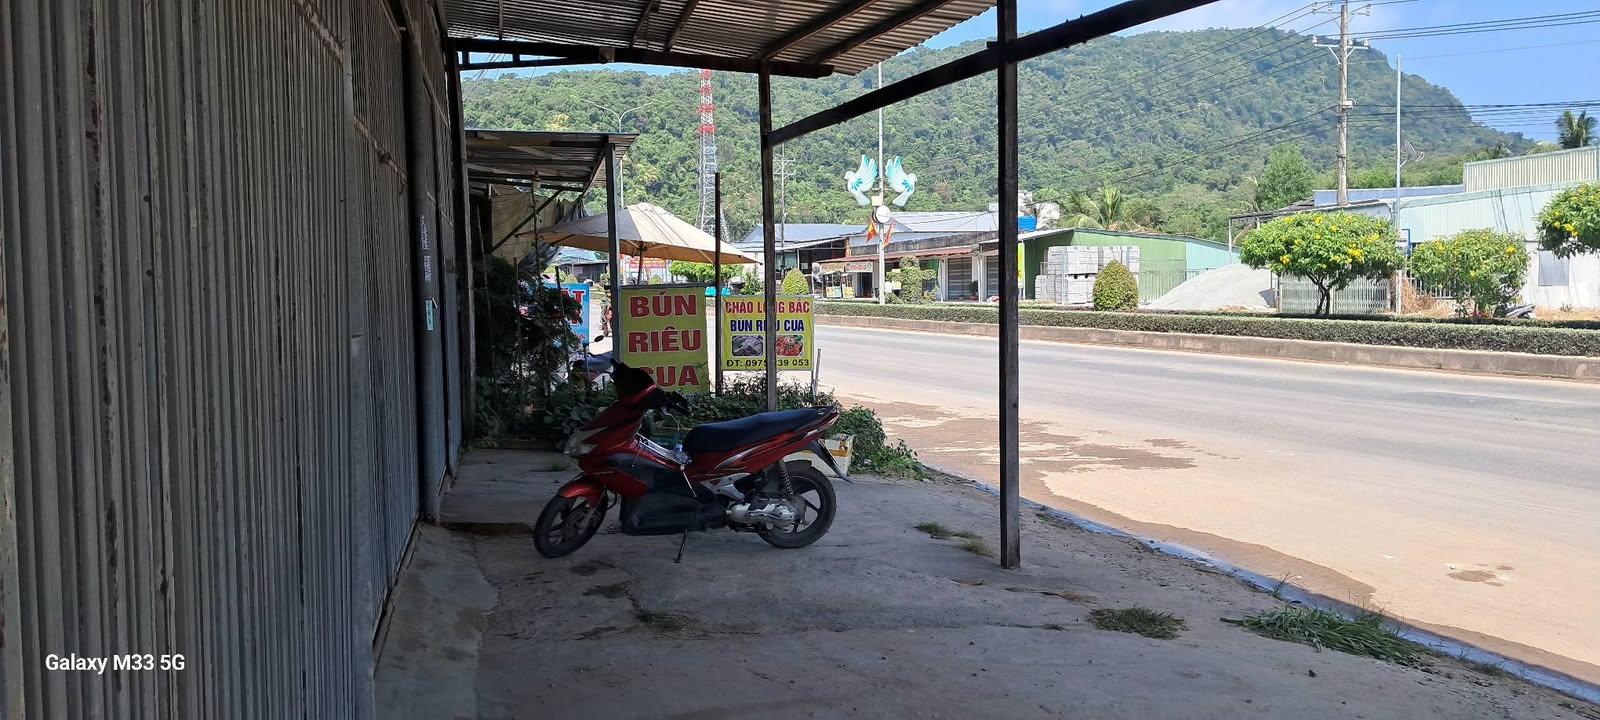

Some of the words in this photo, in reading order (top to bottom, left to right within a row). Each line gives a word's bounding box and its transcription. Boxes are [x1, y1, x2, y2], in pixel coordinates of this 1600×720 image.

[630, 291, 697, 317] BÚN
[726, 298, 754, 313] CHÁO
[757, 301, 785, 313] LG
[789, 297, 810, 313] BẮC
[730, 317, 753, 332] BÚN
[784, 319, 805, 332] CUA
[629, 326, 701, 353] RIÊU
[726, 359, 743, 367] ĐT:
[792, 359, 809, 367] 053
